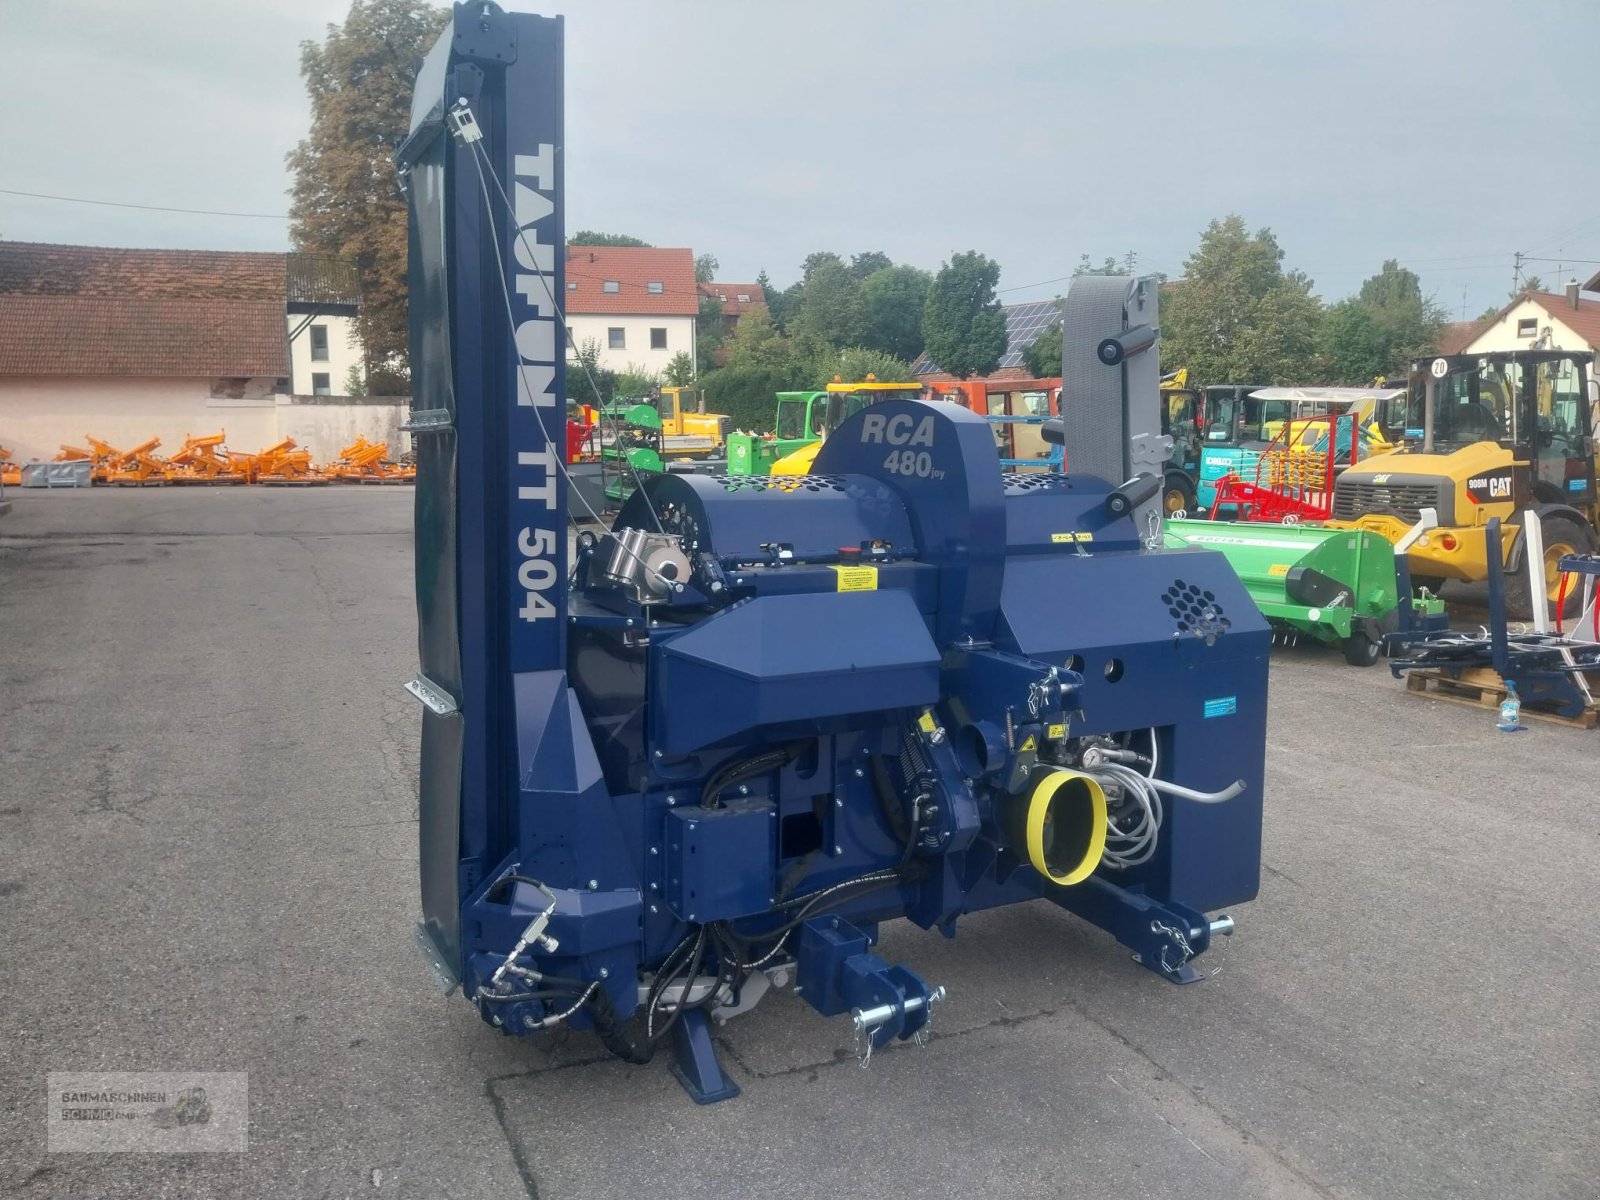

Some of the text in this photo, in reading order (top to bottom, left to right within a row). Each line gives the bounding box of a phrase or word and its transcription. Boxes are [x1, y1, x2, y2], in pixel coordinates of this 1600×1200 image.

[514, 143, 557, 622] TAJFUN TT 504
[1434, 361, 1445, 375] 20
[860, 413, 935, 447] RCA
[883, 449, 945, 480] 480 joy
[1468, 476, 1512, 498] 908M CAT
